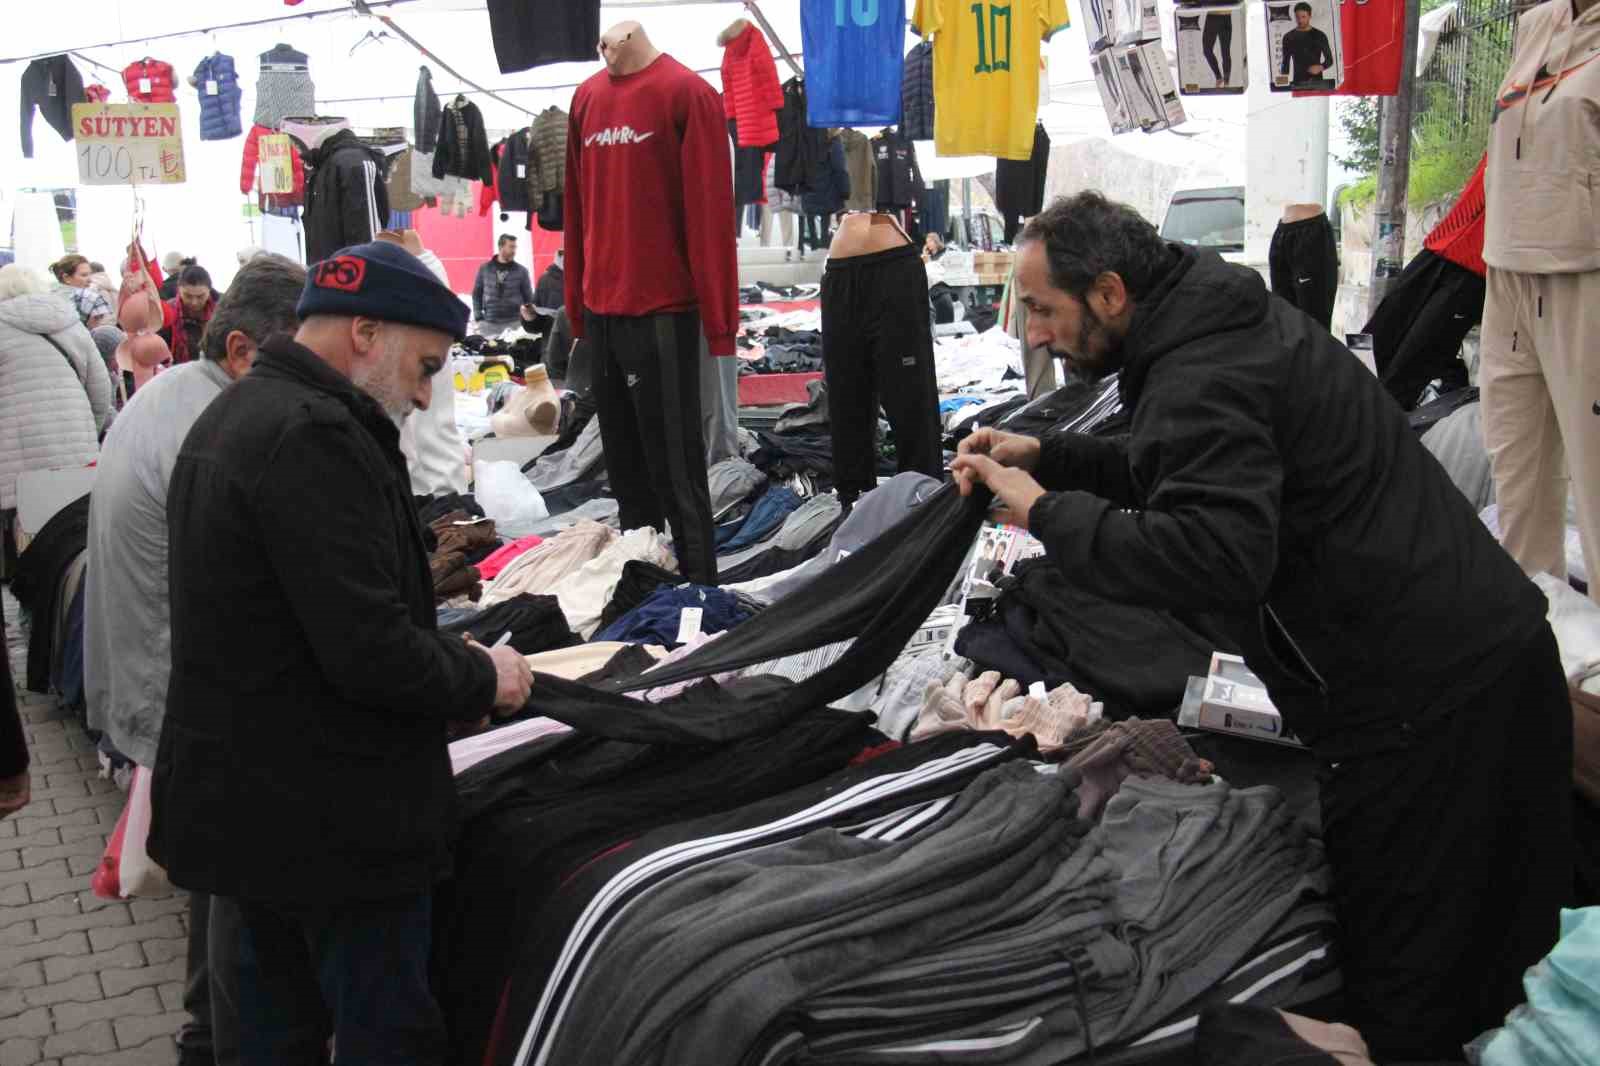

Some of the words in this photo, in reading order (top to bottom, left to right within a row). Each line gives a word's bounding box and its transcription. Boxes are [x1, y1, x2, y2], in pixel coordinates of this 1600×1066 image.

[970, 3, 1011, 73] 10
[79, 112, 177, 137] SÜTYEN
[81, 145, 133, 179] 100
